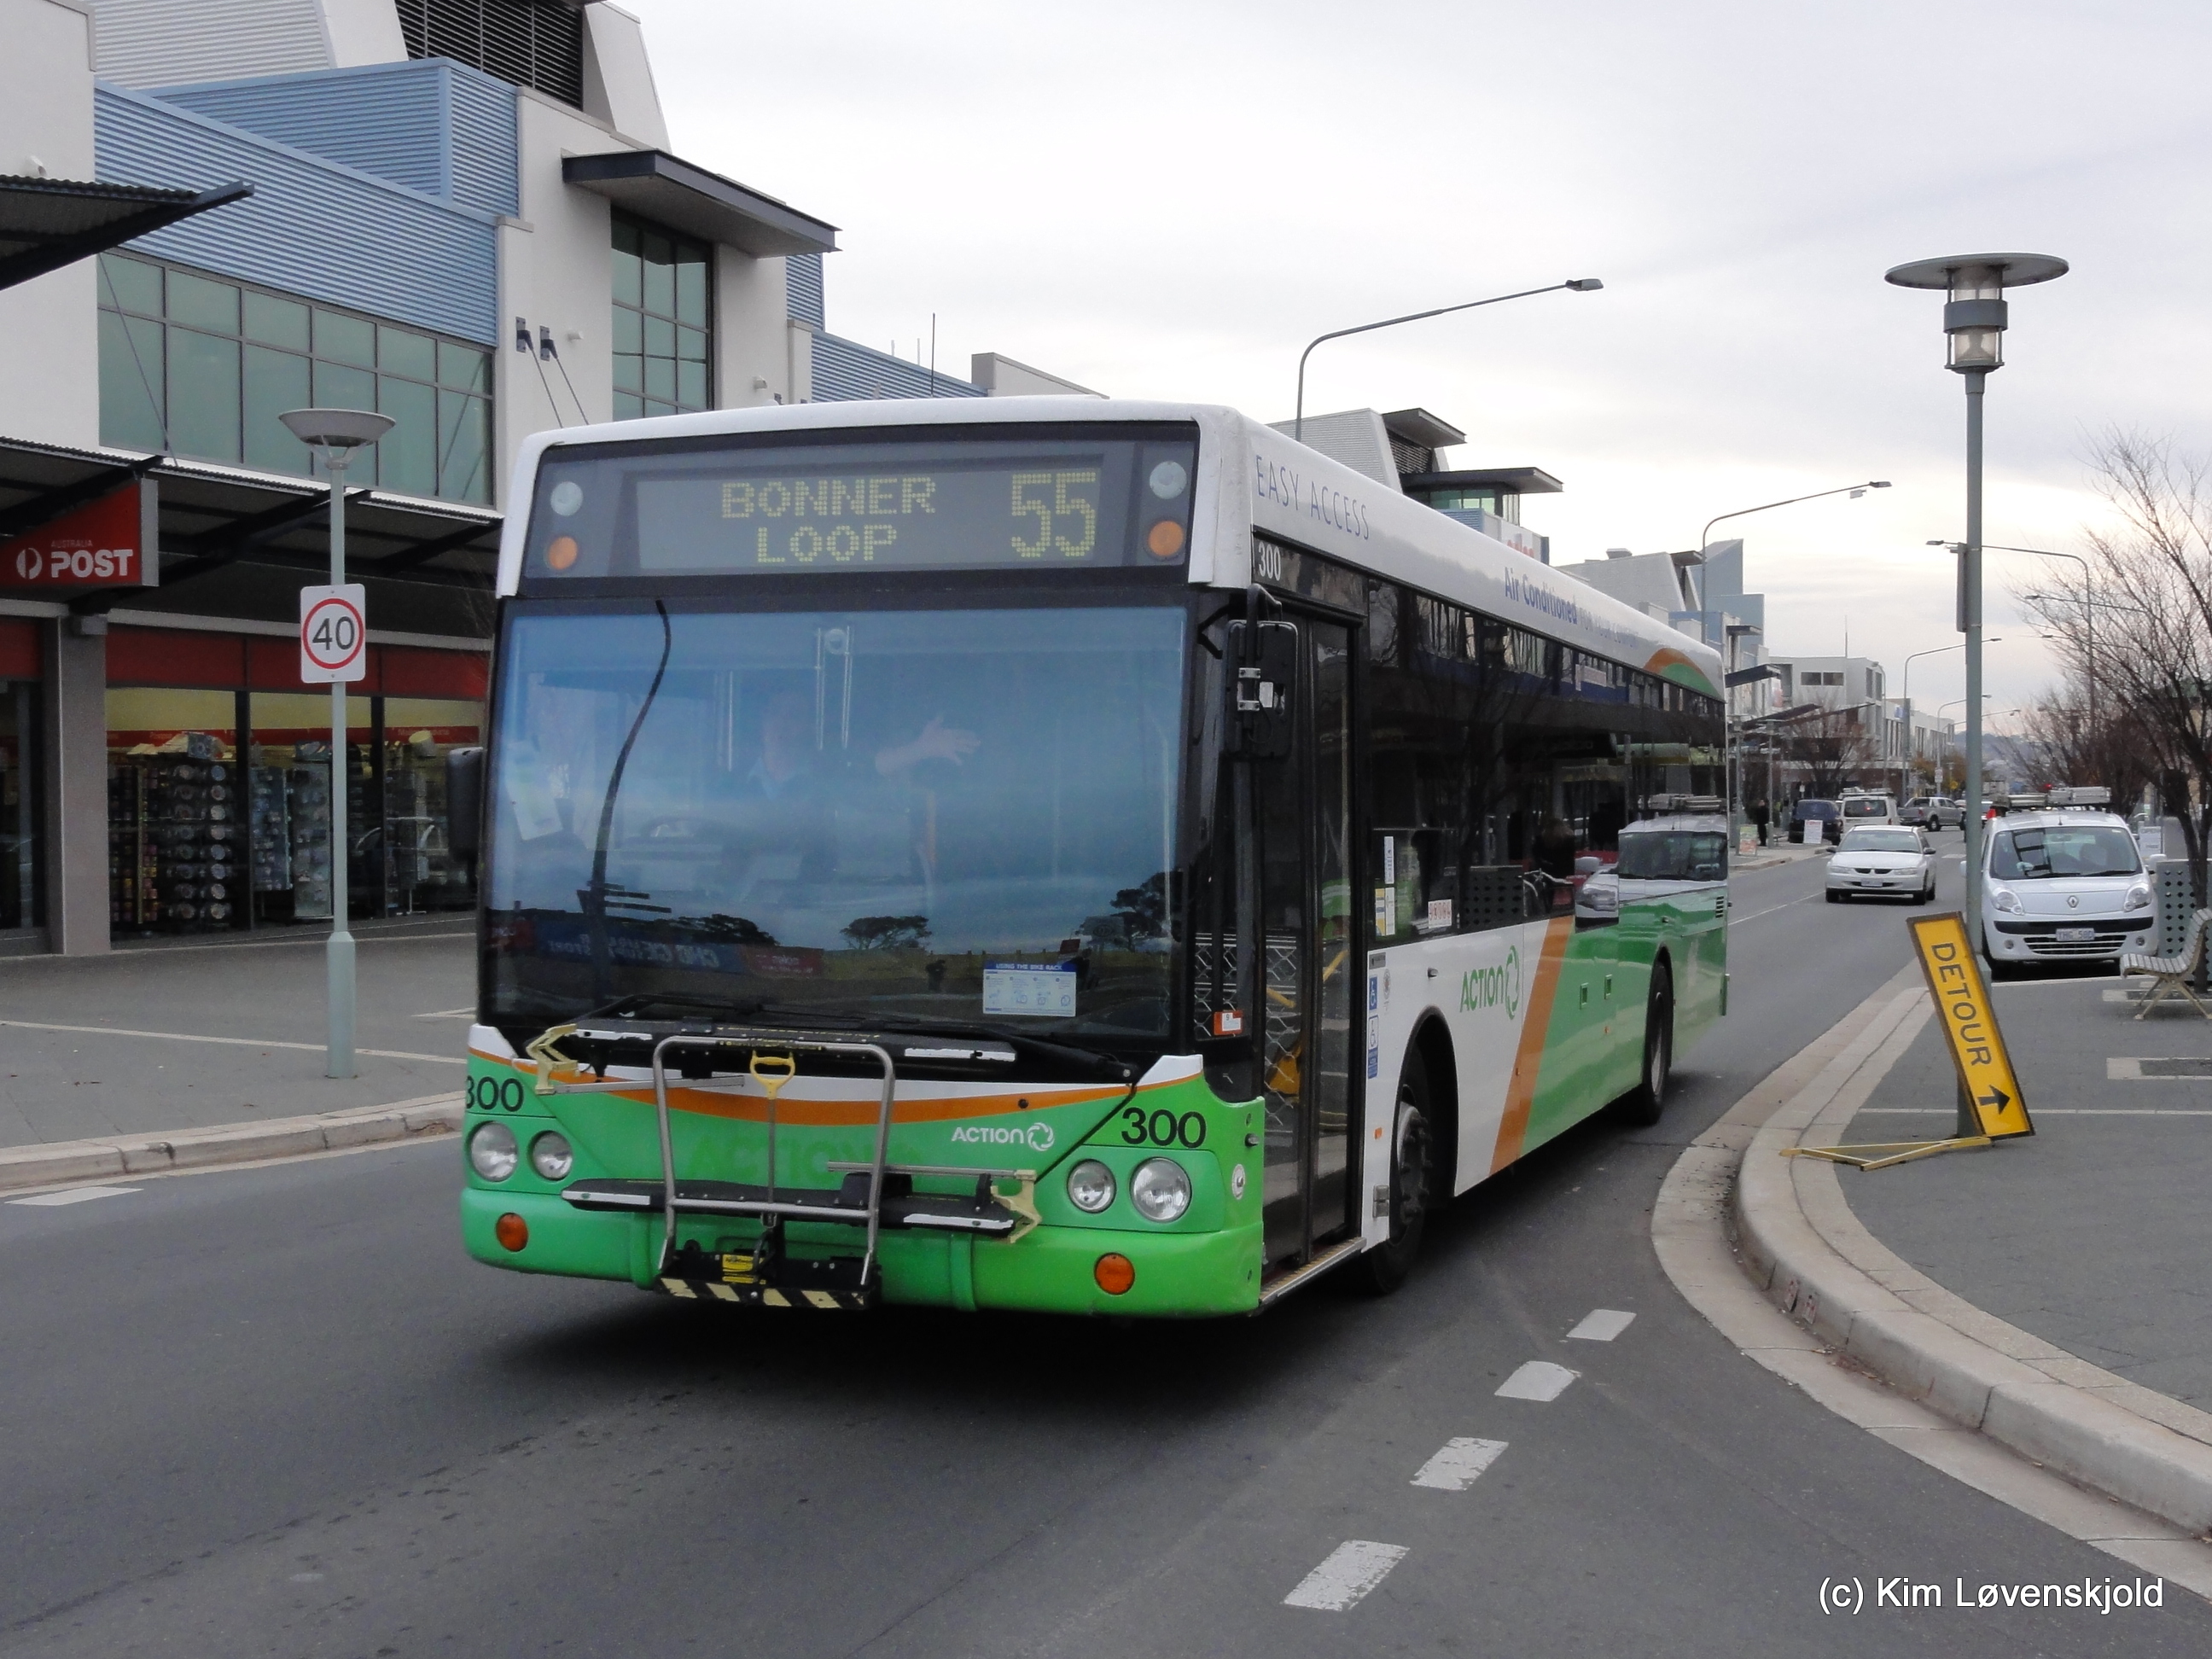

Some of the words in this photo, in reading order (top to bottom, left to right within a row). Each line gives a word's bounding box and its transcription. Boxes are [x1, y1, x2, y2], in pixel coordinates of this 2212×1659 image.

[721, 476, 936, 518] BONNER
[1010, 471, 1097, 558] 55
[1255, 454, 1299, 511] EASY
[1310, 480, 1369, 540] ACCESS
[51, 549, 133, 578] POST
[757, 525, 897, 564] LOOP
[1258, 542, 1280, 581] 300
[1505, 566, 1519, 602] Air
[1522, 573, 1578, 625] Conditioned
[311, 616, 356, 651] 40
[1460, 963, 1505, 1013] ACTION
[1930, 942, 1992, 1066] DETOUR
[951, 1126, 1024, 1144] ACTION
[1121, 1107, 1207, 1149] 300
